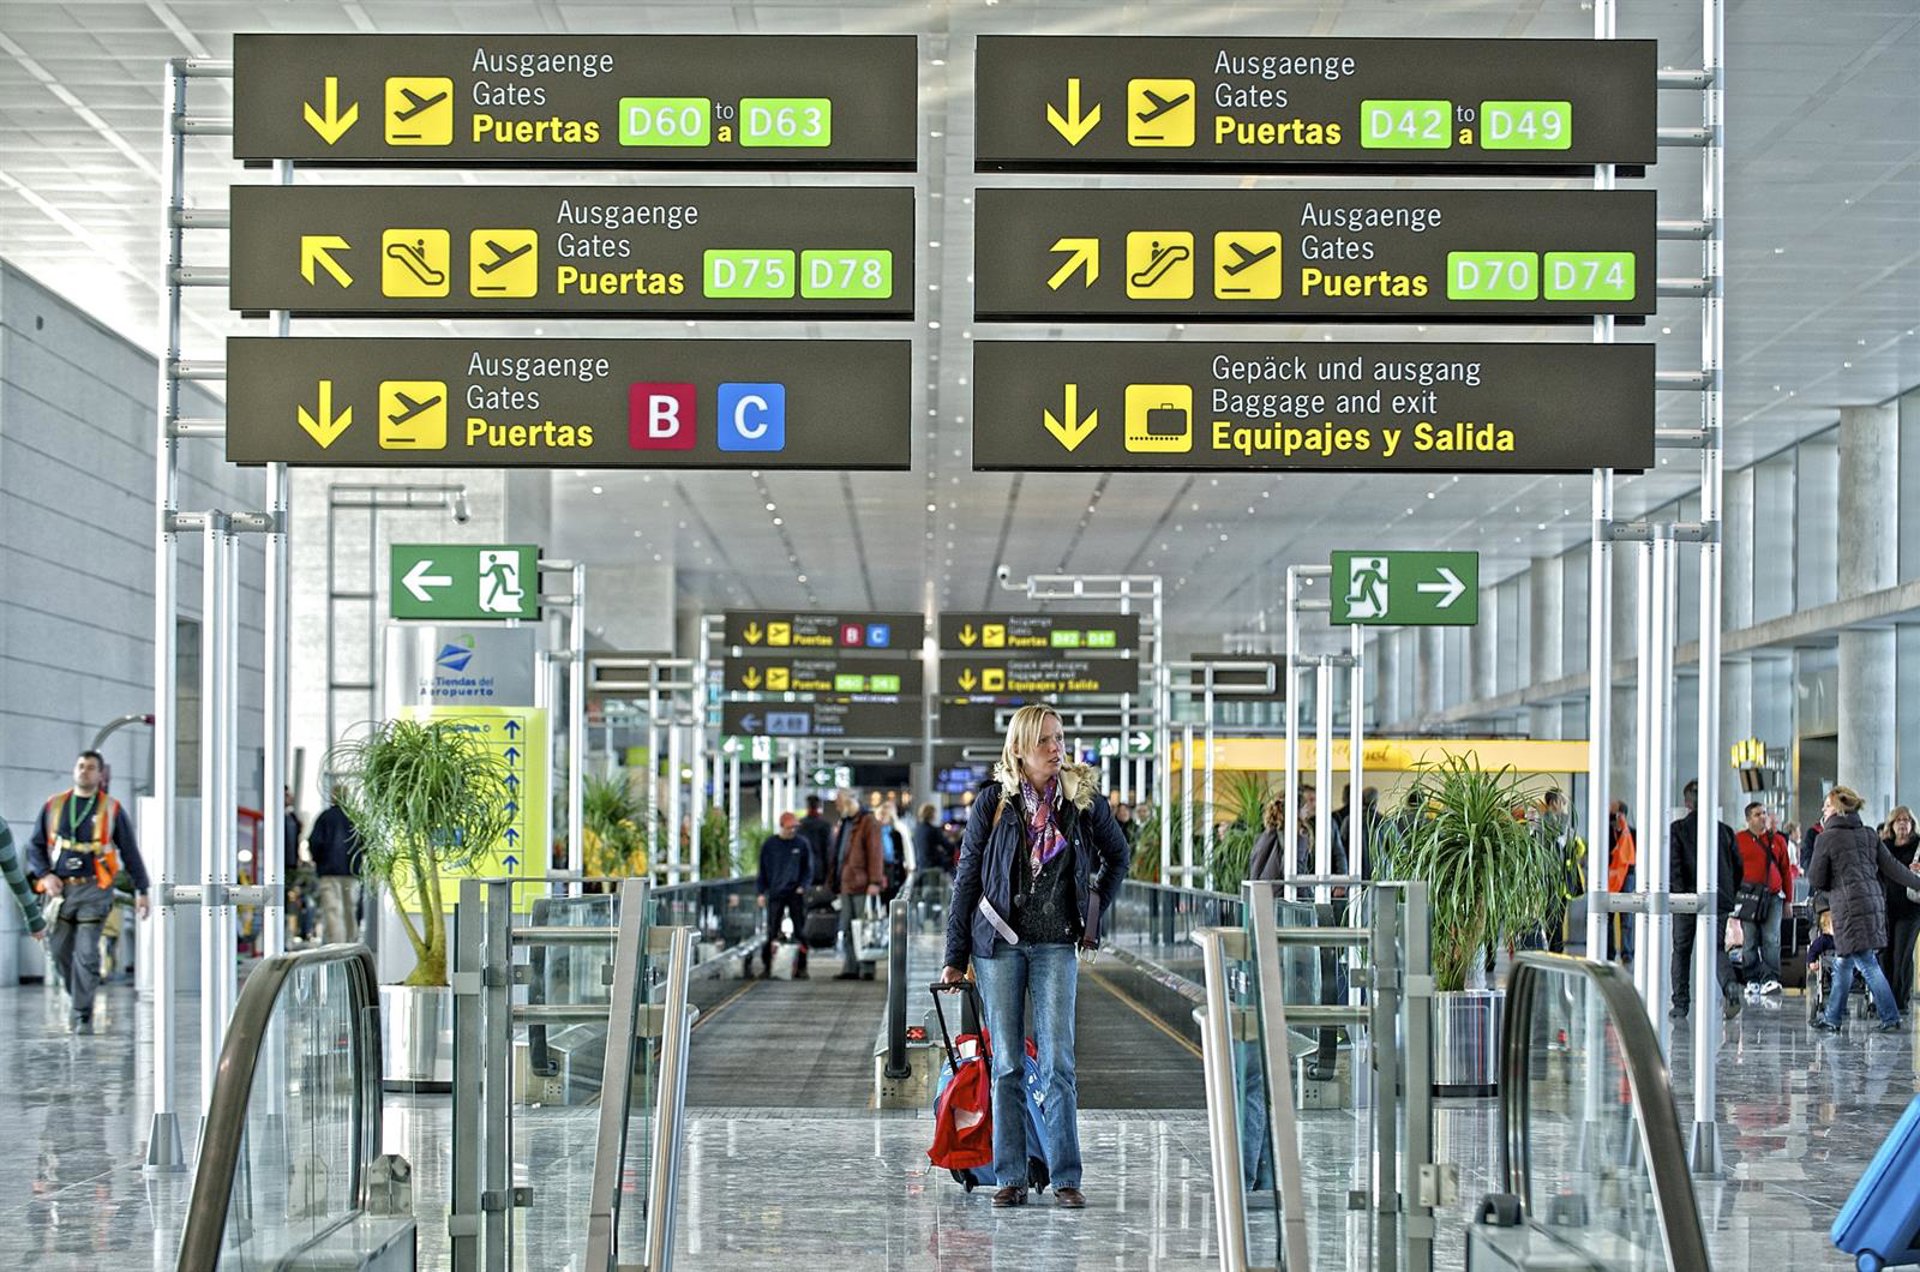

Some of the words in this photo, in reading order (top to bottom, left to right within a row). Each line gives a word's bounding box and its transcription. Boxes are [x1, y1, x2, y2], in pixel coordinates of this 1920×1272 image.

[473, 49, 613, 77] Ausgaenge
[1215, 51, 1354, 79] Ausgaenge
[474, 81, 545, 105] Gates
[1216, 83, 1287, 107] Gates
[474, 115, 599, 144] Puertas
[628, 106, 702, 138] D60
[718, 126, 731, 143] a
[750, 106, 823, 138] D63
[716, 103, 733, 119] to
[1457, 106, 1474, 121] to
[1216, 117, 1340, 144] Puertas
[1371, 109, 1442, 141] D42
[1459, 127, 1474, 145] a
[1488, 109, 1562, 141] D49
[558, 200, 697, 229] Ausgaenge
[1301, 203, 1441, 231] Ausgaenge
[558, 233, 630, 257] Gates
[1302, 235, 1373, 259] Gates
[558, 265, 685, 295] Puertas
[713, 258, 785, 290] D75
[810, 258, 882, 290] D78
[1303, 269, 1427, 296] Puertas
[1457, 260, 1529, 291] D70
[1554, 260, 1626, 291] D74
[468, 353, 608, 381] Ausgaenge
[1213, 356, 1306, 384] Gepäck
[1319, 357, 1361, 380] und
[1374, 363, 1480, 385] ausgang
[467, 385, 539, 409] Gates
[1213, 389, 1324, 418] Baggage
[1337, 390, 1380, 413] and
[1393, 390, 1437, 413] exit
[467, 419, 594, 448] Puertas
[649, 395, 679, 437] B
[735, 396, 767, 438] C
[1213, 422, 1369, 455] Equipajes
[1383, 430, 1401, 456] y
[1415, 421, 1513, 452] Salida
[846, 627, 858, 643] B
[872, 627, 882, 643] C
[436, 677, 476, 686] Tiendas
[478, 676, 494, 686] del
